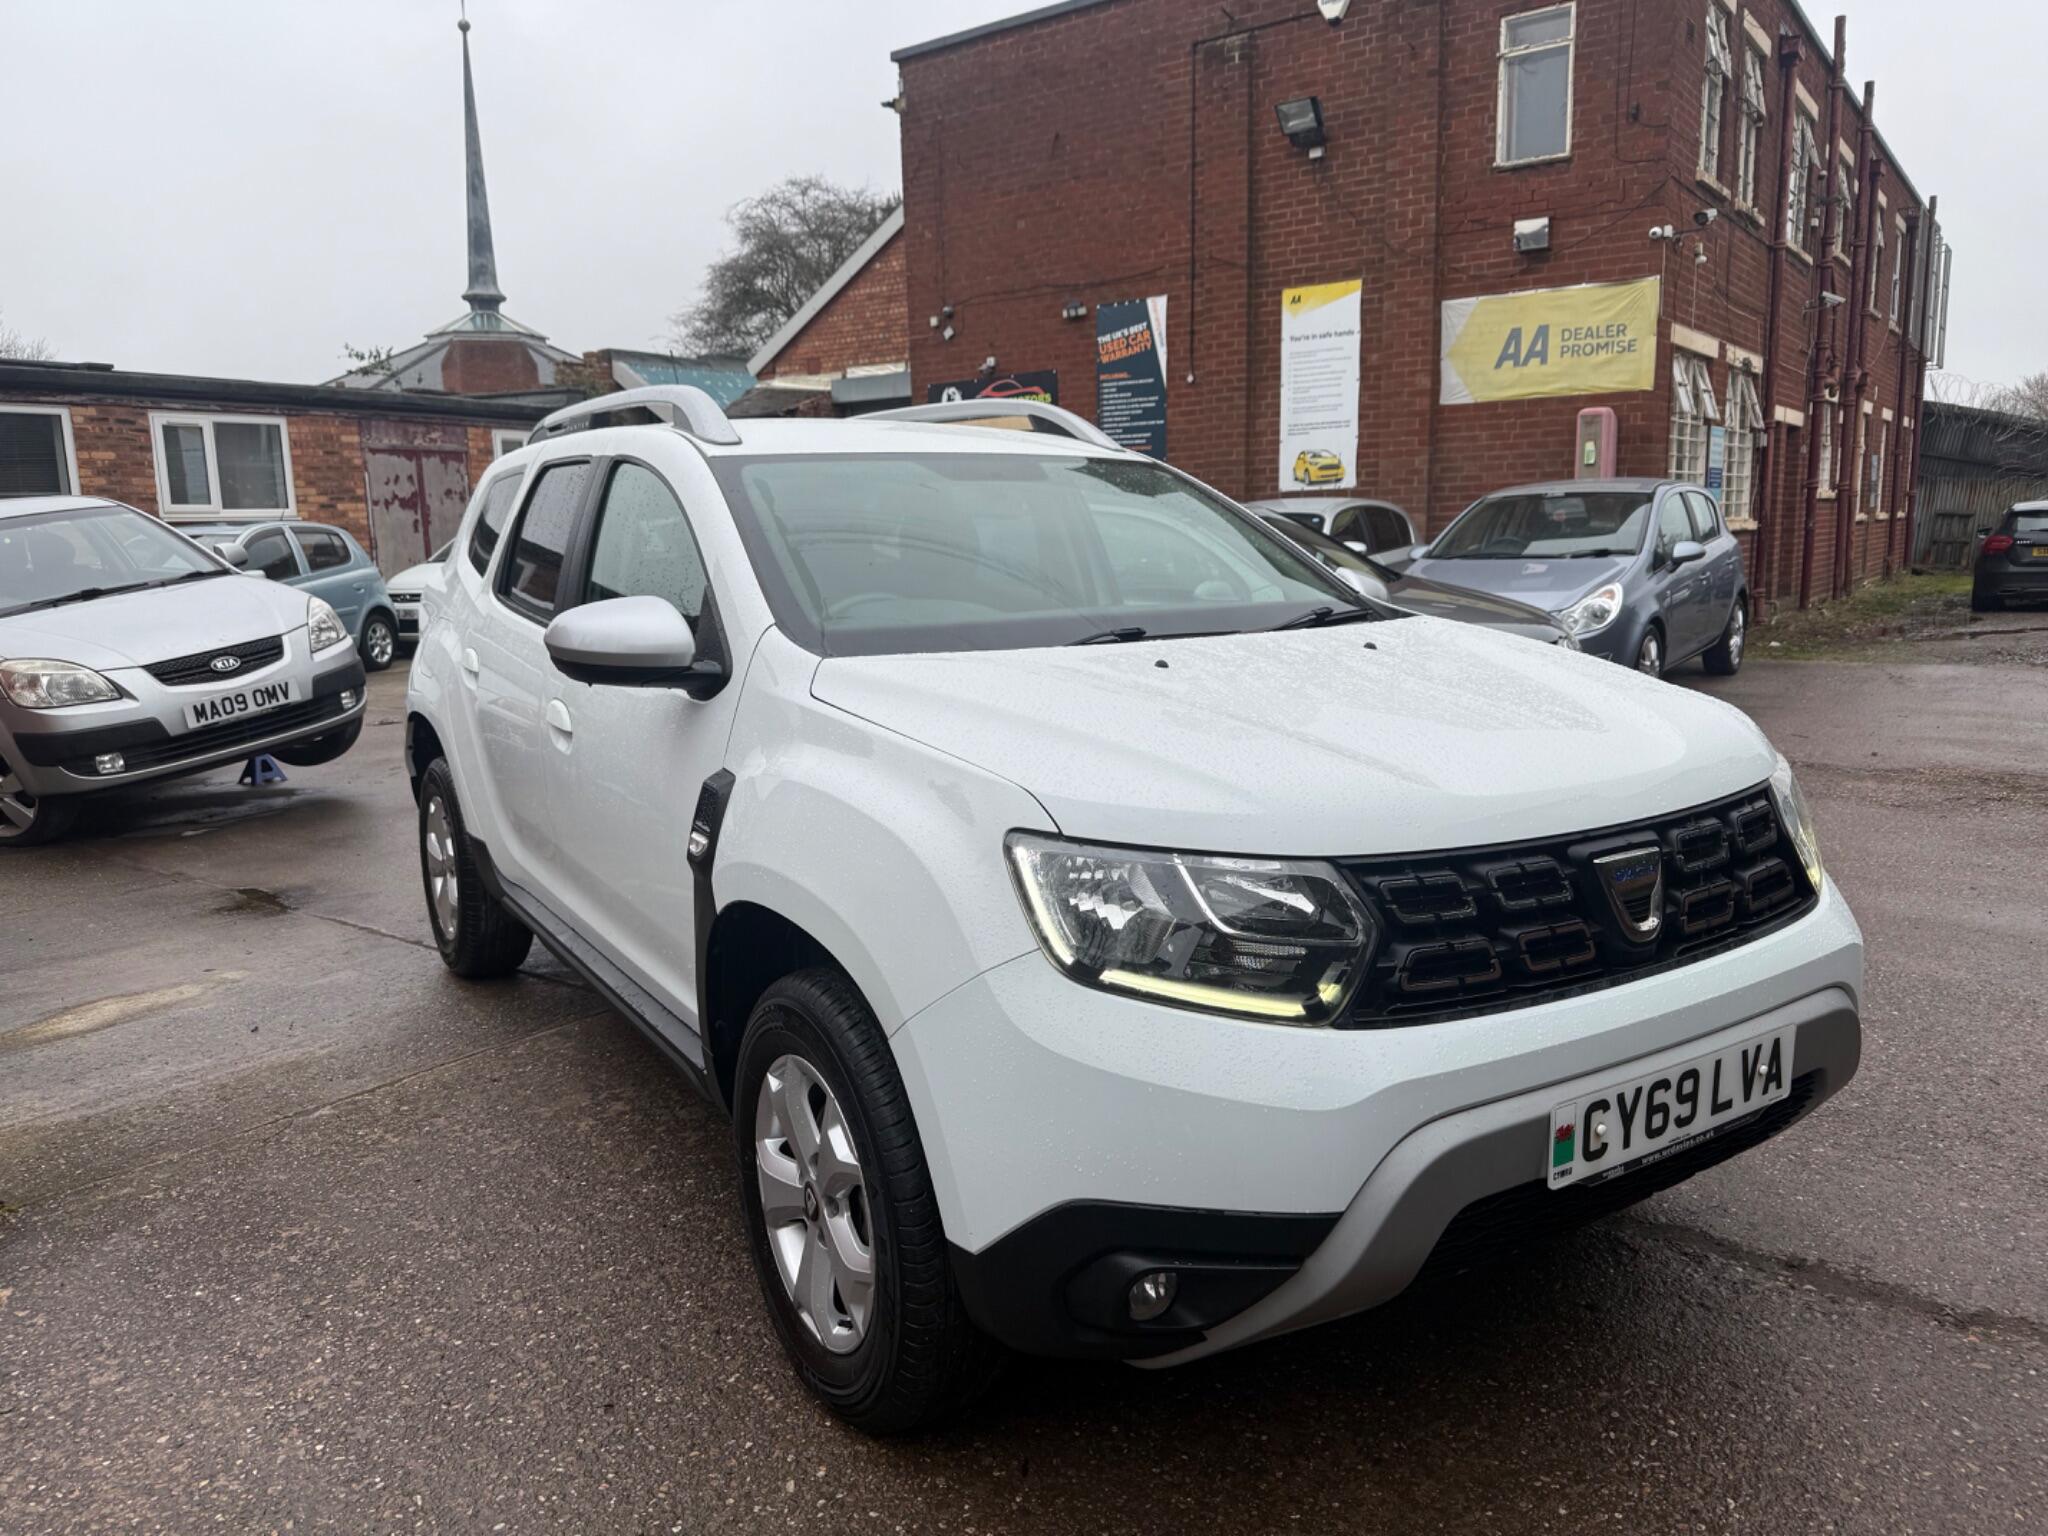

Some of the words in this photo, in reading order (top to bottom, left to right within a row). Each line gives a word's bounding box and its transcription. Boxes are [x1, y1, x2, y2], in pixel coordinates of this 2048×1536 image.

[1100, 337, 1127, 354] USED
[1129, 329, 1152, 345] CAR
[1290, 334, 1310, 343] You're
[1319, 331, 1332, 339] safe
[1333, 329, 1355, 337] hands
[1560, 323, 1628, 341] DEALER
[1101, 341, 1152, 364] WARRANTY
[1494, 324, 1550, 370] AA
[1560, 338, 1637, 358] PROMISE
[215, 658, 237, 669] KIA
[193, 693, 249, 723] MA09
[252, 682, 290, 706] OMV
[1582, 1068, 1700, 1162] CY69
[1711, 1037, 1783, 1117] LVA
